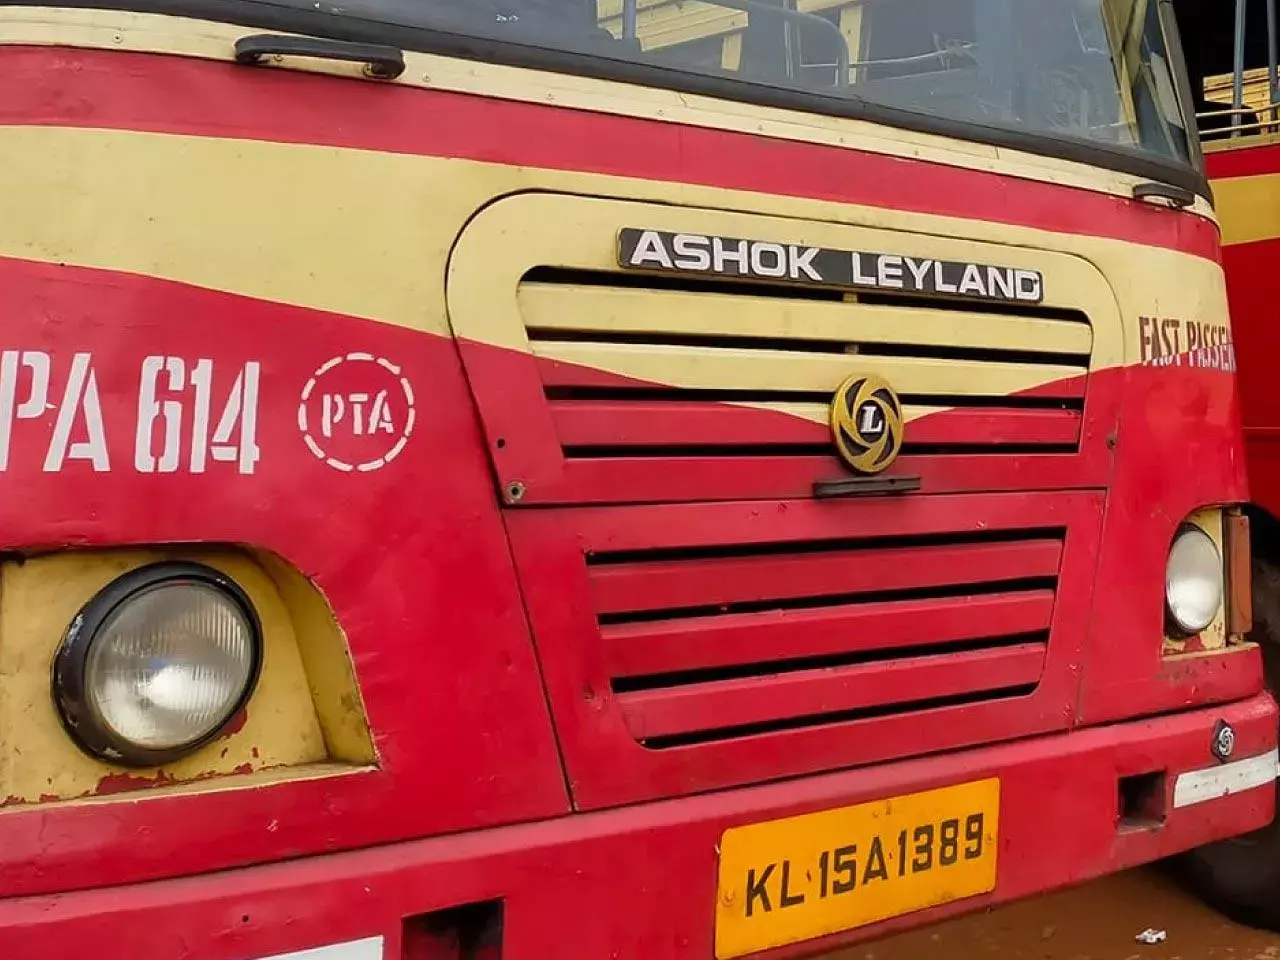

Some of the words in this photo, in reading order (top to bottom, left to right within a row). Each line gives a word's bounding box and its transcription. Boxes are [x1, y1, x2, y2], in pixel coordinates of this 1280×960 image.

[629, 229, 824, 282] ASHOK
[850, 251, 1041, 302] LEYLAND
[1138, 316, 1182, 367] FAST
[134, 355, 261, 475] 614
[321, 390, 395, 438] PTA
